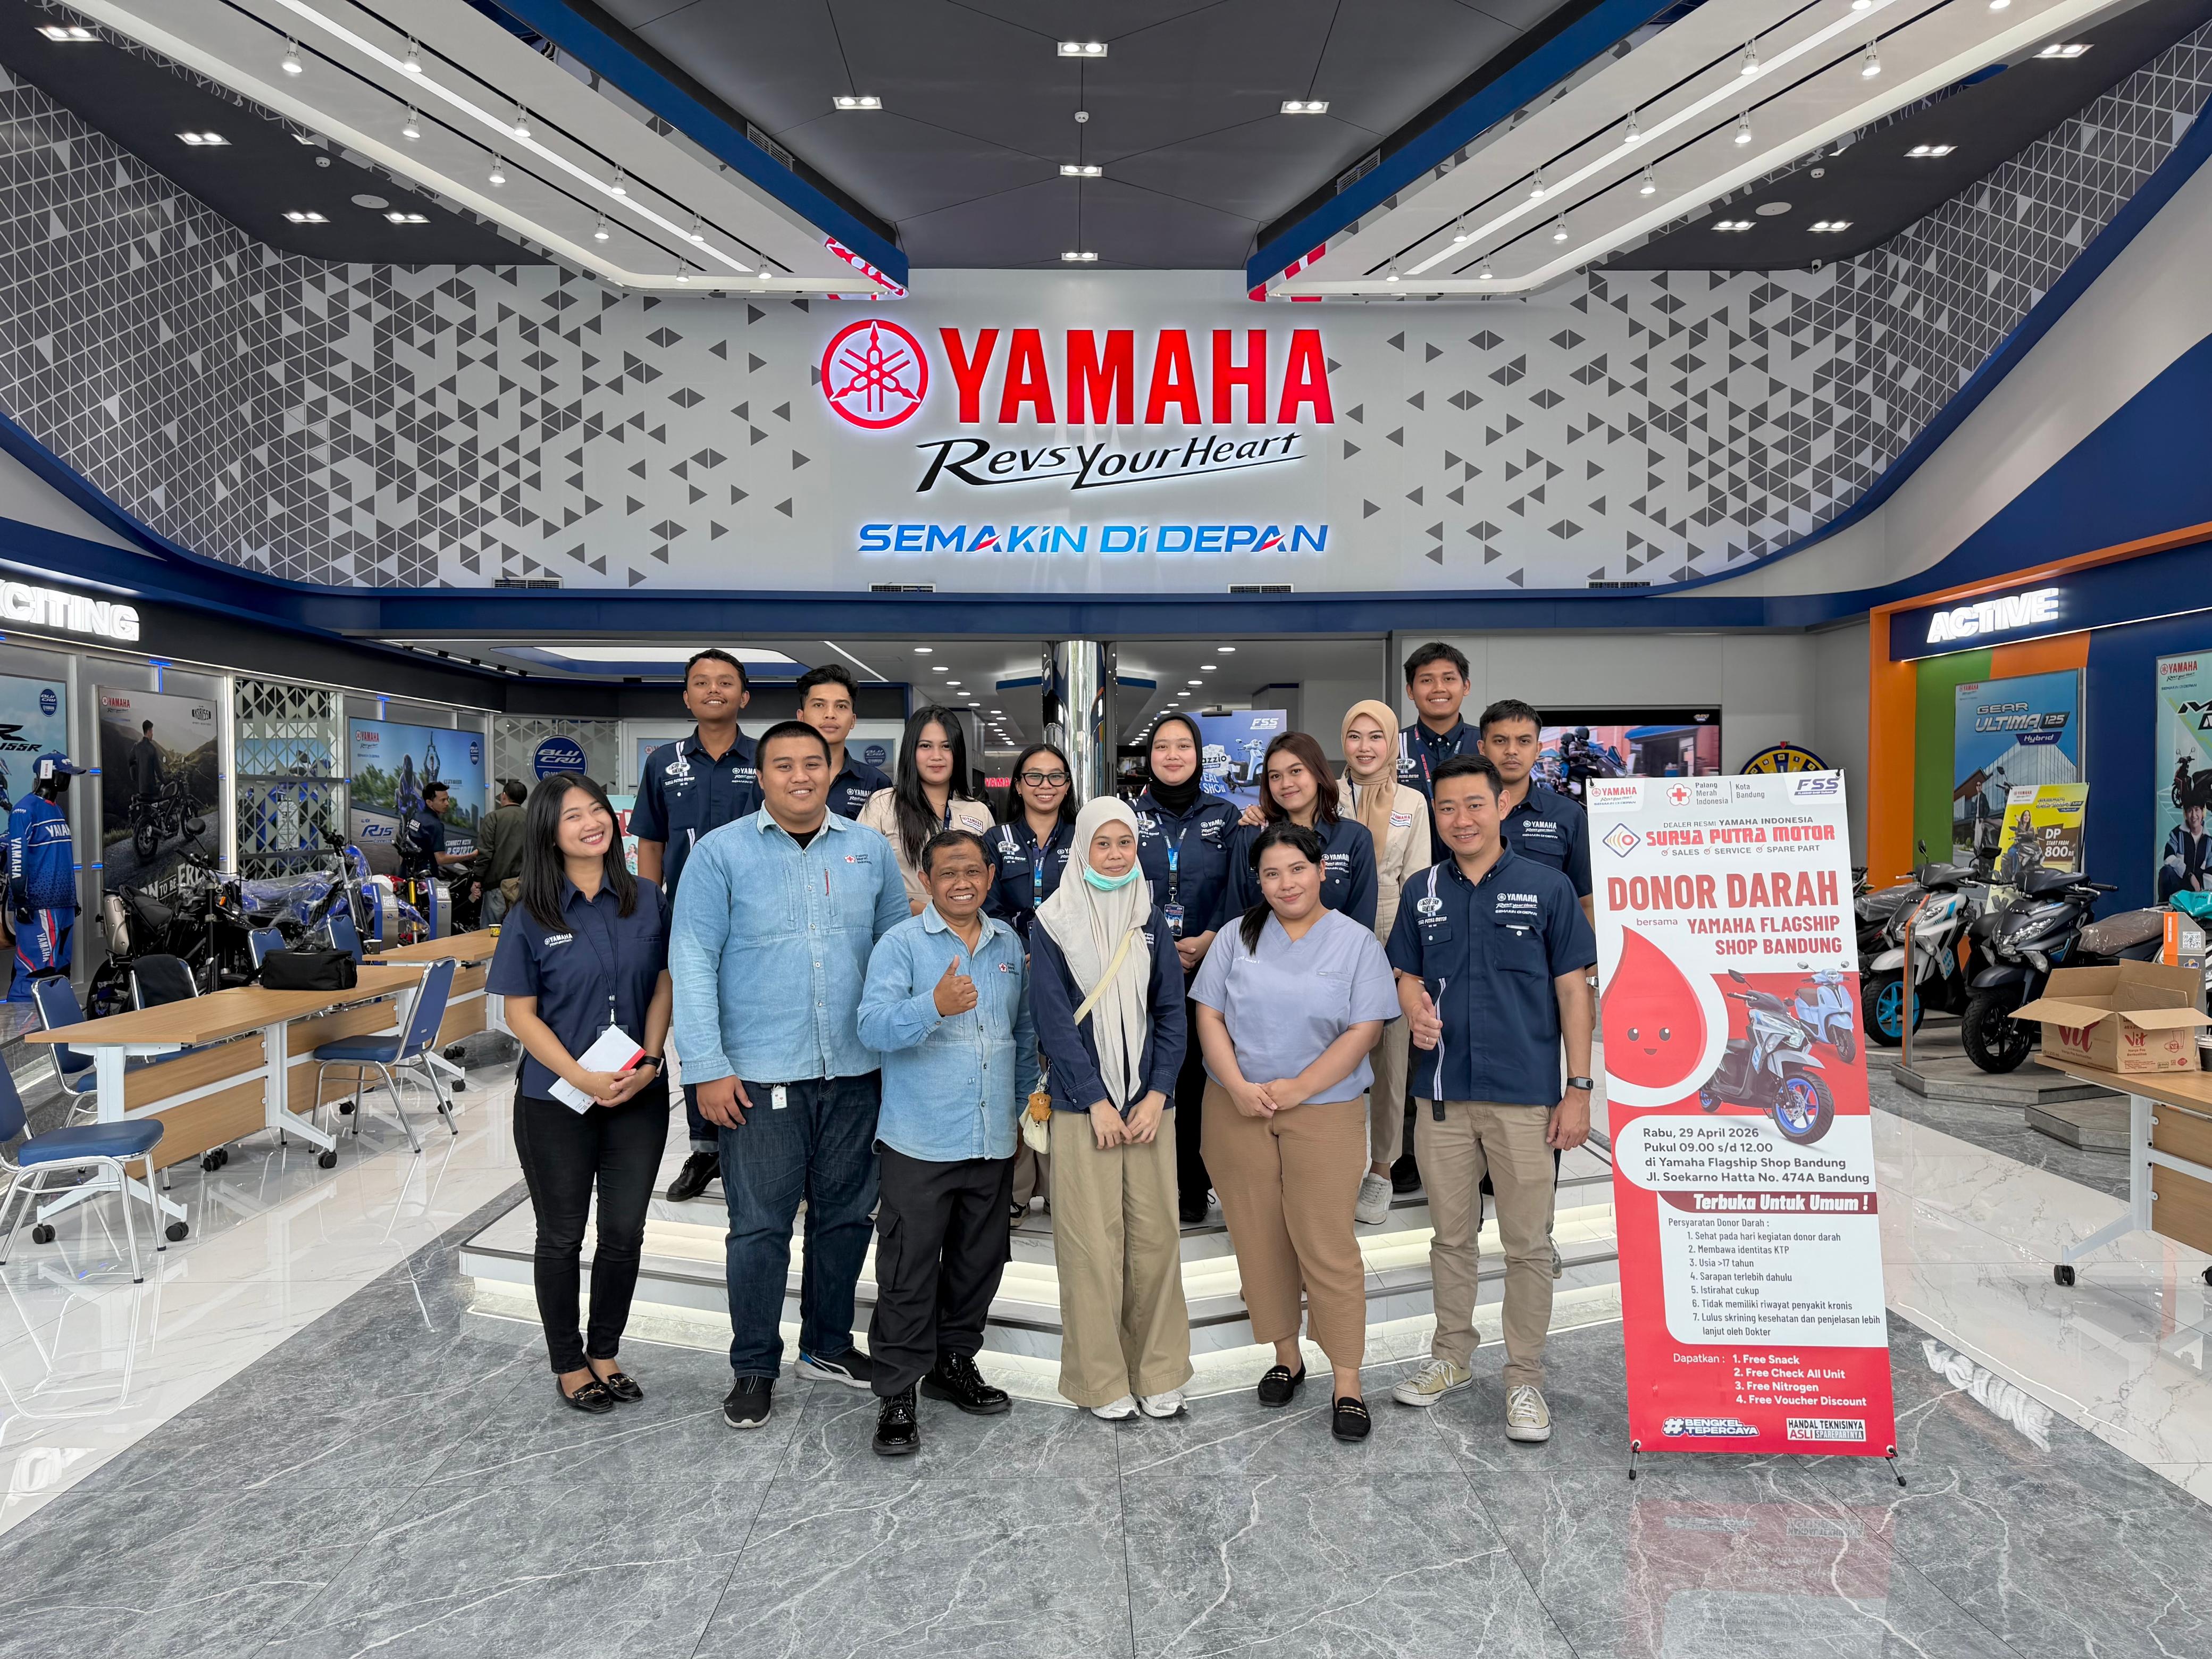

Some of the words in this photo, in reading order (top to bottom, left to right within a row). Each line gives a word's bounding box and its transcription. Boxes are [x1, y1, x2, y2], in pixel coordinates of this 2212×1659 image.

[940, 328, 1334, 424] YAMAHA
[1156, 524, 1328, 552] DEPAN
[0, 580, 139, 641] CITING
[1927, 588, 2058, 643] ACTIVE
[2169, 661, 2197, 673] YAMAHA
[108, 697, 130, 708] YAMAHA
[1977, 702, 2029, 715] GEAR
[1252, 718, 1279, 726] FSS
[1975, 714, 2041, 732] ULTIMA
[2045, 715, 2065, 725] 125
[361, 732, 379, 742] YAMAHA
[2024, 734, 2054, 743] Hybrid
[1202, 754, 1227, 764] azzio
[985, 777, 1010, 787] YAMA
[1797, 777, 1841, 790] FSS
[1203, 783, 1226, 794] SHOW
[1602, 787, 1637, 795] YAMAHA
[362, 825, 393, 836] R15
[1646, 830, 1704, 846] SURYA
[1710, 827, 1767, 844] PUTRA
[1773, 825, 1835, 842] MOTOR
[2045, 828, 2062, 839] DP
[2045, 847, 2068, 857] 800
[11, 837, 21, 879] YAMAHA
[160, 884, 167, 896] TO
[1607, 875, 1716, 911] DONOR
[1727, 870, 1839, 908] DARAH
[1507, 893, 1538, 903] YAMAHA
[1636, 918, 1678, 926] bersama
[1687, 917, 1755, 934] YAMAHA
[1761, 916, 1840, 933] FLAGSHIP
[549, 933, 573, 942] YAMAHA
[37, 933, 51, 962] YAMAHA
[1716, 939, 1757, 956] SHOP
[1763, 937, 1842, 954] BANDUNG
[2124, 1032, 2148, 1046] Vit
[1643, 1128, 1675, 1139] Rabu,
[1679, 1128, 1694, 1137] 29
[1697, 1128, 1724, 1140] April
[1729, 1128, 1759, 1138] 2026
[1644, 1143, 1676, 1152] Pukul
[1679, 1143, 1714, 1153] 09.00
[1718, 1143, 1737, 1153] s/d
[1740, 1143, 1773, 1153] 12.00
[1645, 1158, 1655, 1167] di
[1659, 1158, 1705, 1167] Yamaha
[1708, 1158, 1757, 1169] Flagship
[1761, 1158, 1791, 1170] Shop
[1794, 1158, 1846, 1170] Bandung
[1646, 1172, 1660, 1182] Jl.
[1663, 1172, 1718, 1182] Soekarno
[1721, 1173, 1755, 1182] Hatta
[1758, 1173, 1779, 1183] No.
[1782, 1173, 1815, 1183] 474A
[1819, 1174, 1870, 1185] Bandung
[1693, 1193, 1756, 1210] Terbuka
[1760, 1194, 1805, 1211] Untuk
[1809, 1195, 1858, 1211] Umum
[1669, 1218, 1715, 1228] Persyaratan
[1742, 1219, 1764, 1227] Darah
[1695, 1231, 1717, 1240] Sehat
[1719, 1232, 1738, 1242] pada
[1740, 1232, 1755, 1241] hari
[1757, 1233, 1791, 1242] kegiatan
[1794, 1233, 1816, 1241] donor
[1698, 1245, 1736, 1254] Membawa
[1738, 1245, 1772, 1254] identitas
[1699, 1259, 1715, 1267] Usia
[1700, 1272, 1731, 1283] Sarapan
[1733, 1272, 1764, 1281] terlebih
[1766, 1273, 1792, 1281] dahulu
[1700, 1286, 1733, 1294] Istirahat
[1736, 1286, 1759, 1296] cukup
[1702, 1300, 1723, 1308] Tidak
[1725, 1300, 1758, 1309] memiliki
[1761, 1301, 1789, 1311] riwayat
[1792, 1301, 1825, 1311] penyakit
[1828, 1301, 1853, 1310] kronis
[1702, 1313, 1722, 1322] Lulus
[1724, 1313, 1756, 1323] skrining
[1758, 1314, 1799, 1323] kesehatan
[1801, 1314, 1815, 1323] dan
[1817, 1315, 1859, 1326] penjelasan
[1862, 1316, 1880, 1324] lebih
[1703, 1327, 1724, 1337] lanjut
[1727, 1327, 1743, 1336] oleh
[1745, 1327, 1771, 1336] Dokter
[1673, 1353, 1720, 1365] Dapatkan
[1733, 1354, 1741, 1363] 1.
[1743, 1354, 1766, 1364] Free
[1769, 1355, 1799, 1364] Snack
[1733, 1368, 1744, 1377] 2.
[1746, 1368, 1769, 1377] Free
[1771, 1368, 1804, 1378] Check
[1807, 1369, 1821, 1378] All
[1823, 1369, 1845, 1379] Unit
[1735, 1381, 1745, 1390] 3.
[1747, 1381, 1770, 1390] Free
[1772, 1381, 1819, 1394] Nitrogen
[1736, 1395, 1746, 1404] 4.
[1749, 1395, 1772, 1404] Free
[1774, 1395, 1817, 1405] Voucher
[1821, 1396, 1866, 1406] Discount
[1788, 1420, 1818, 1429] HANDAL
[1820, 1420, 1863, 1430] TEKNISINYA
[1686, 1427, 1758, 1435] TEPERCAYA
[1790, 1429, 1813, 1439] ASLI
[1816, 1431, 1863, 1439] SPAREPARTNYA
